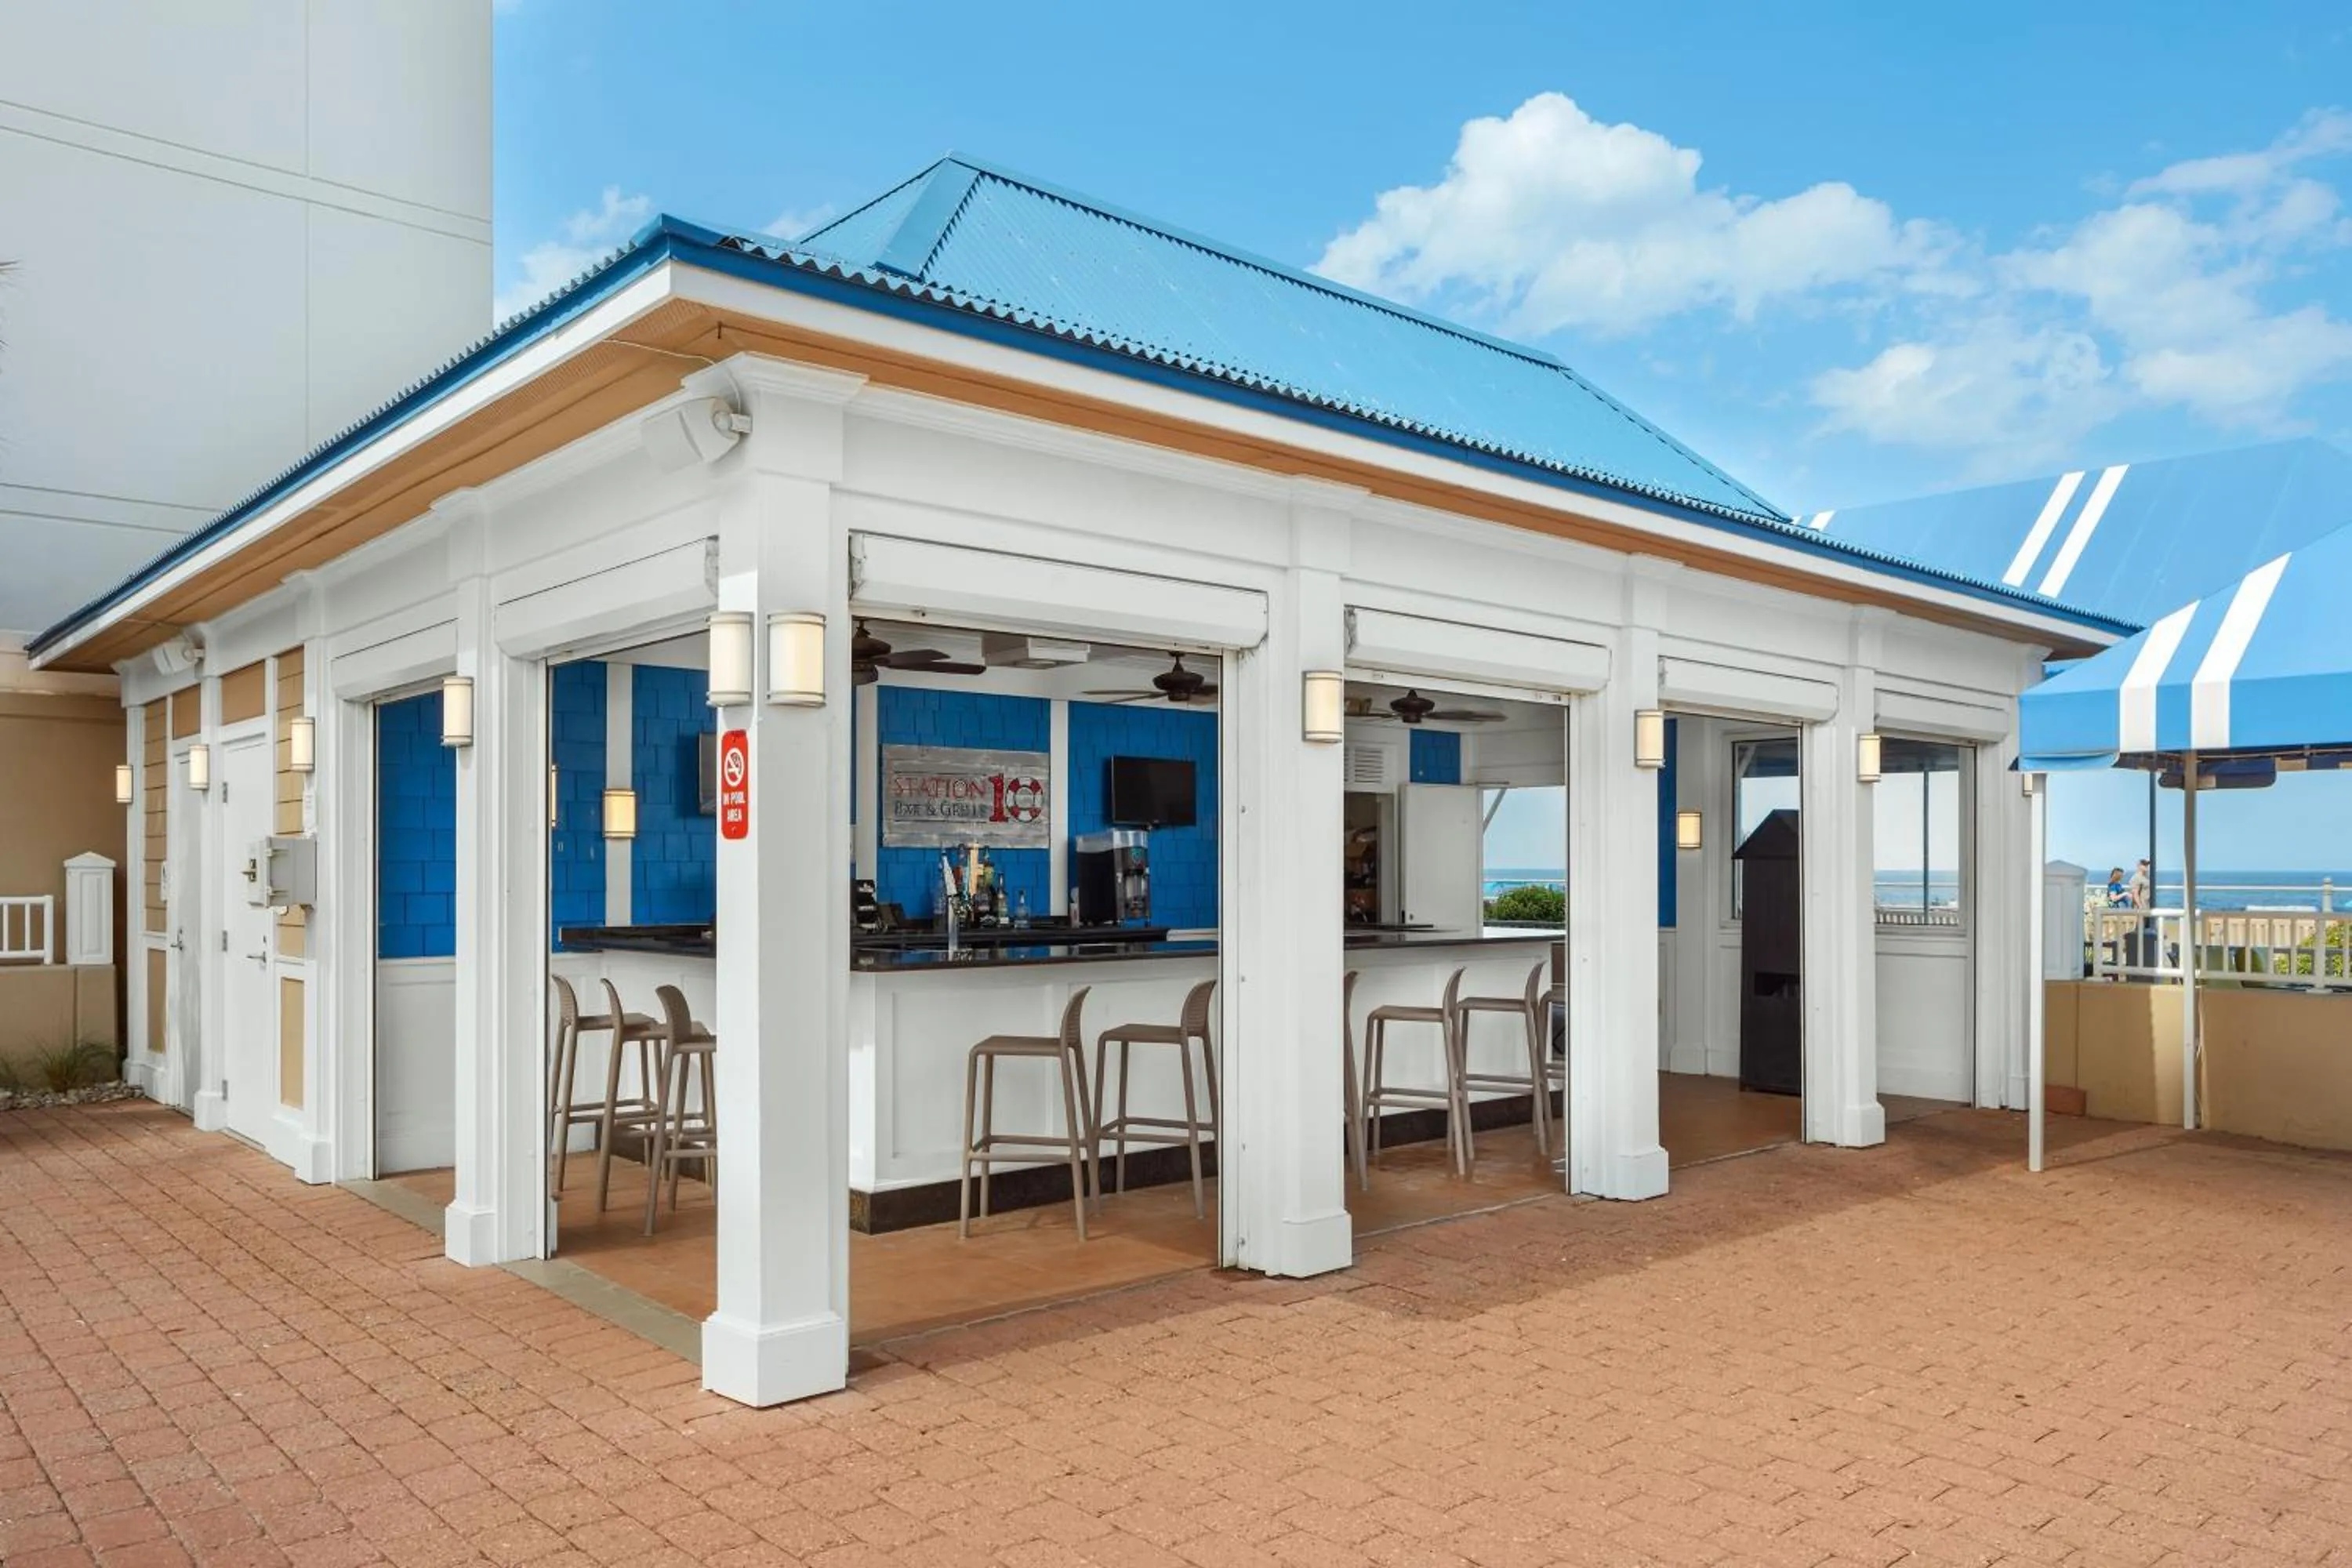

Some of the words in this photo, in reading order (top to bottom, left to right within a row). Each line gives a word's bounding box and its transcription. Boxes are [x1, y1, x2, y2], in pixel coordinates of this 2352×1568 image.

[894, 775, 986, 798] STATION
[988, 772, 1044, 823] 10
[927, 800, 938, 816] &
